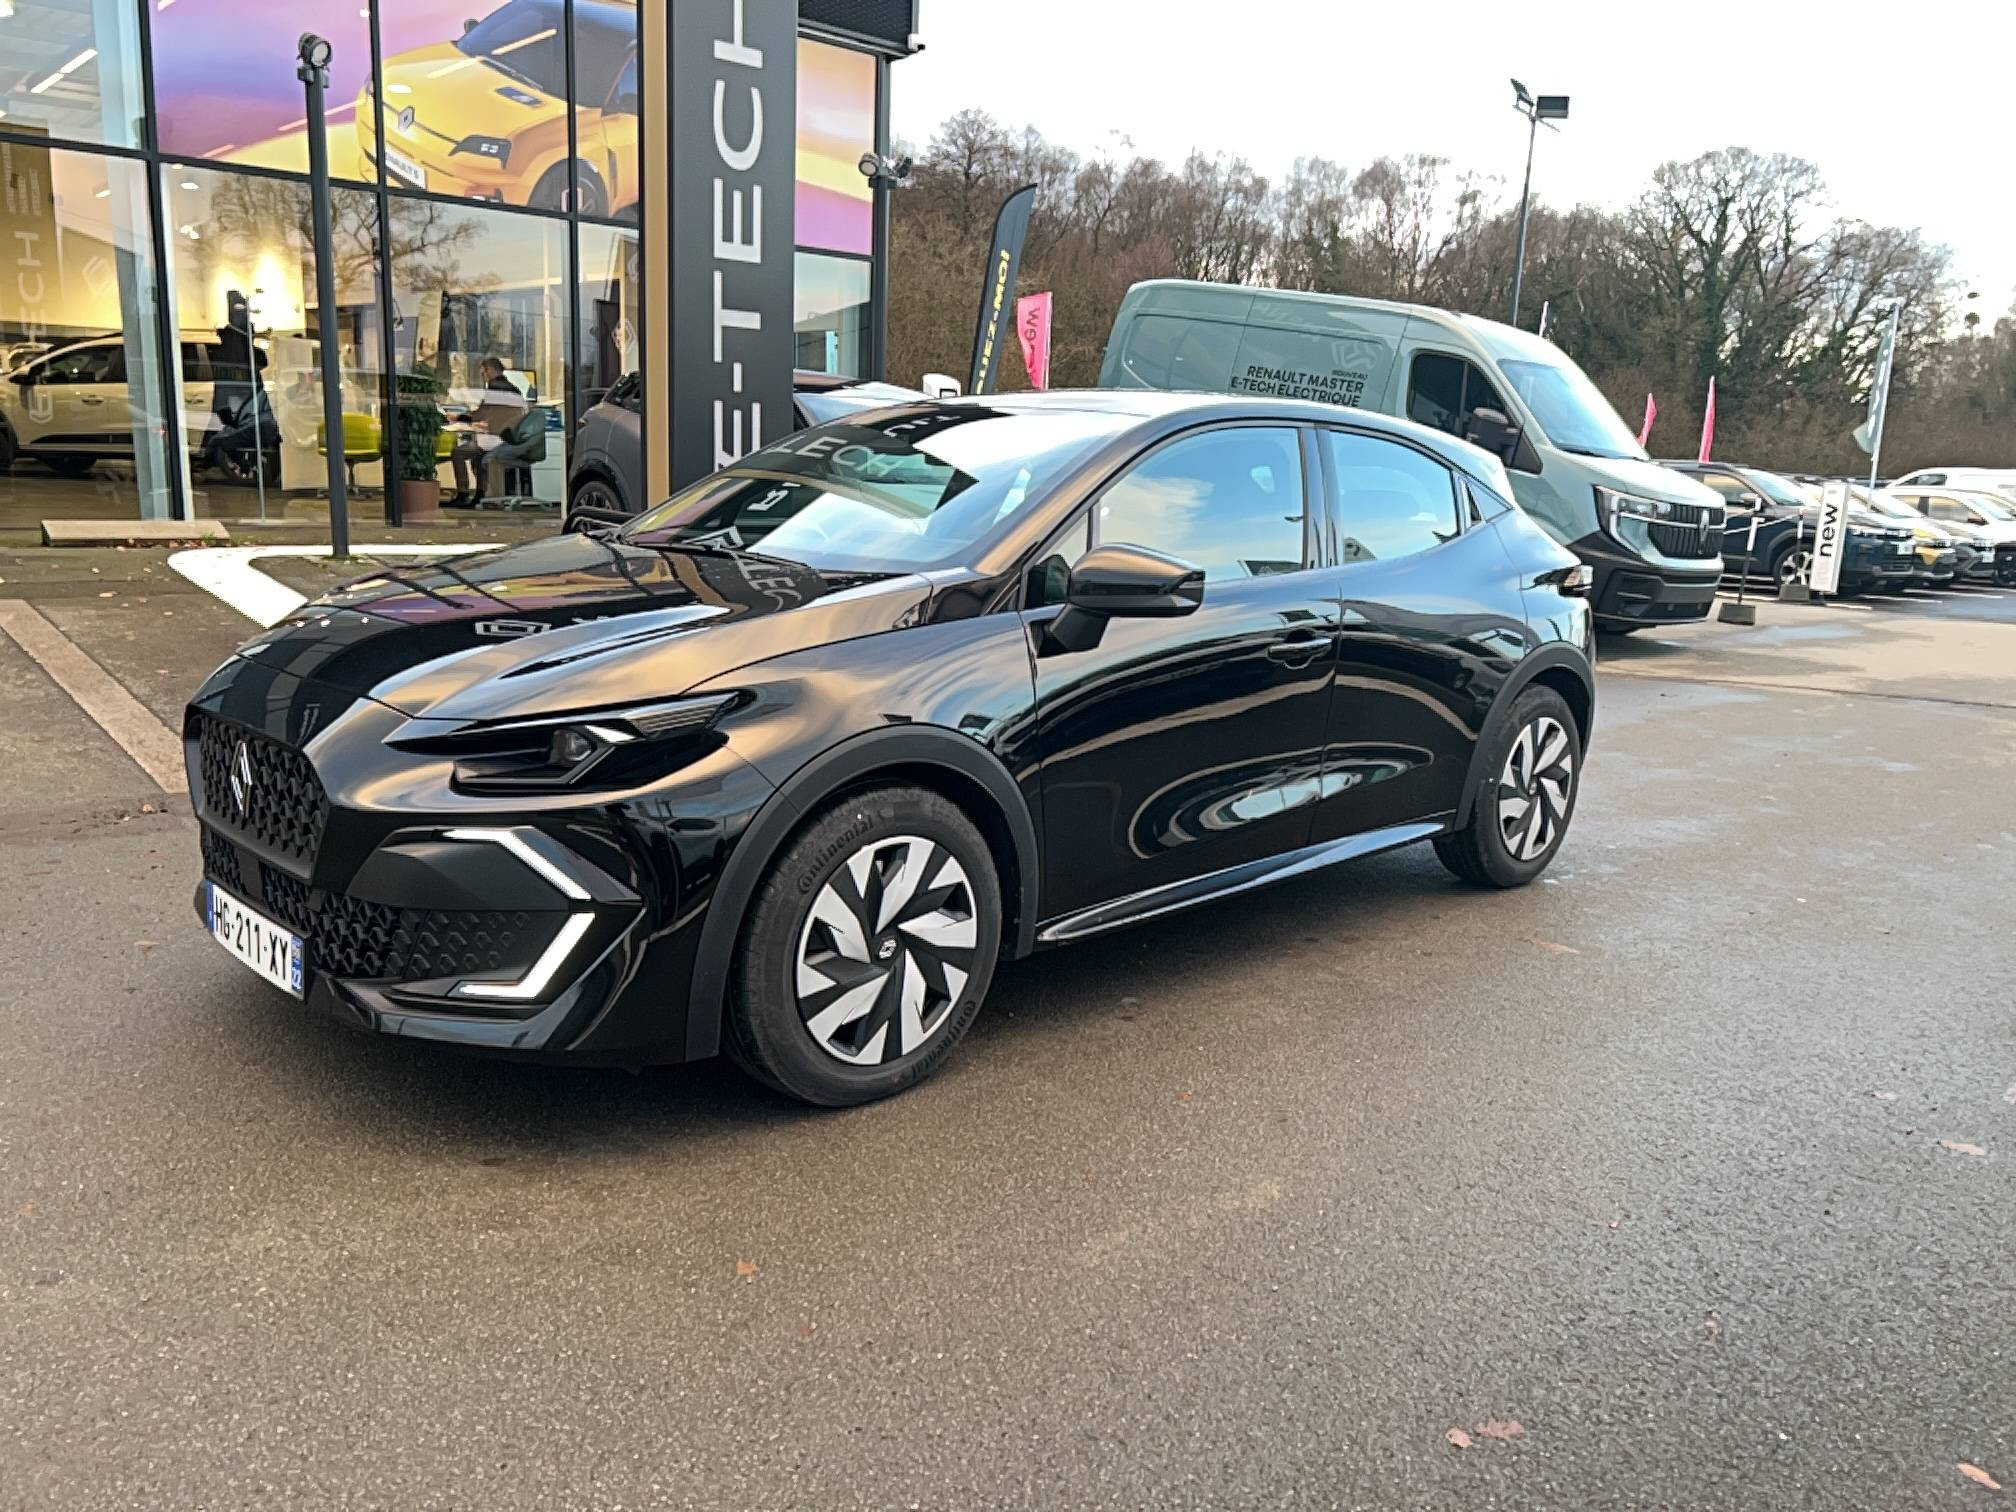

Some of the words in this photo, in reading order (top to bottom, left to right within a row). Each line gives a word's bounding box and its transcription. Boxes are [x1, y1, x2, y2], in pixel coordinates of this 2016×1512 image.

[1230, 376, 1277, 393] E-TECH
[1277, 383, 1361, 407] ELECTRIQUE
[1247, 365, 1307, 385] RENAULT
[1307, 374, 1364, 394] MASTER
[797, 814, 874, 894] Continental
[214, 894, 288, 981] HG-211-XY
